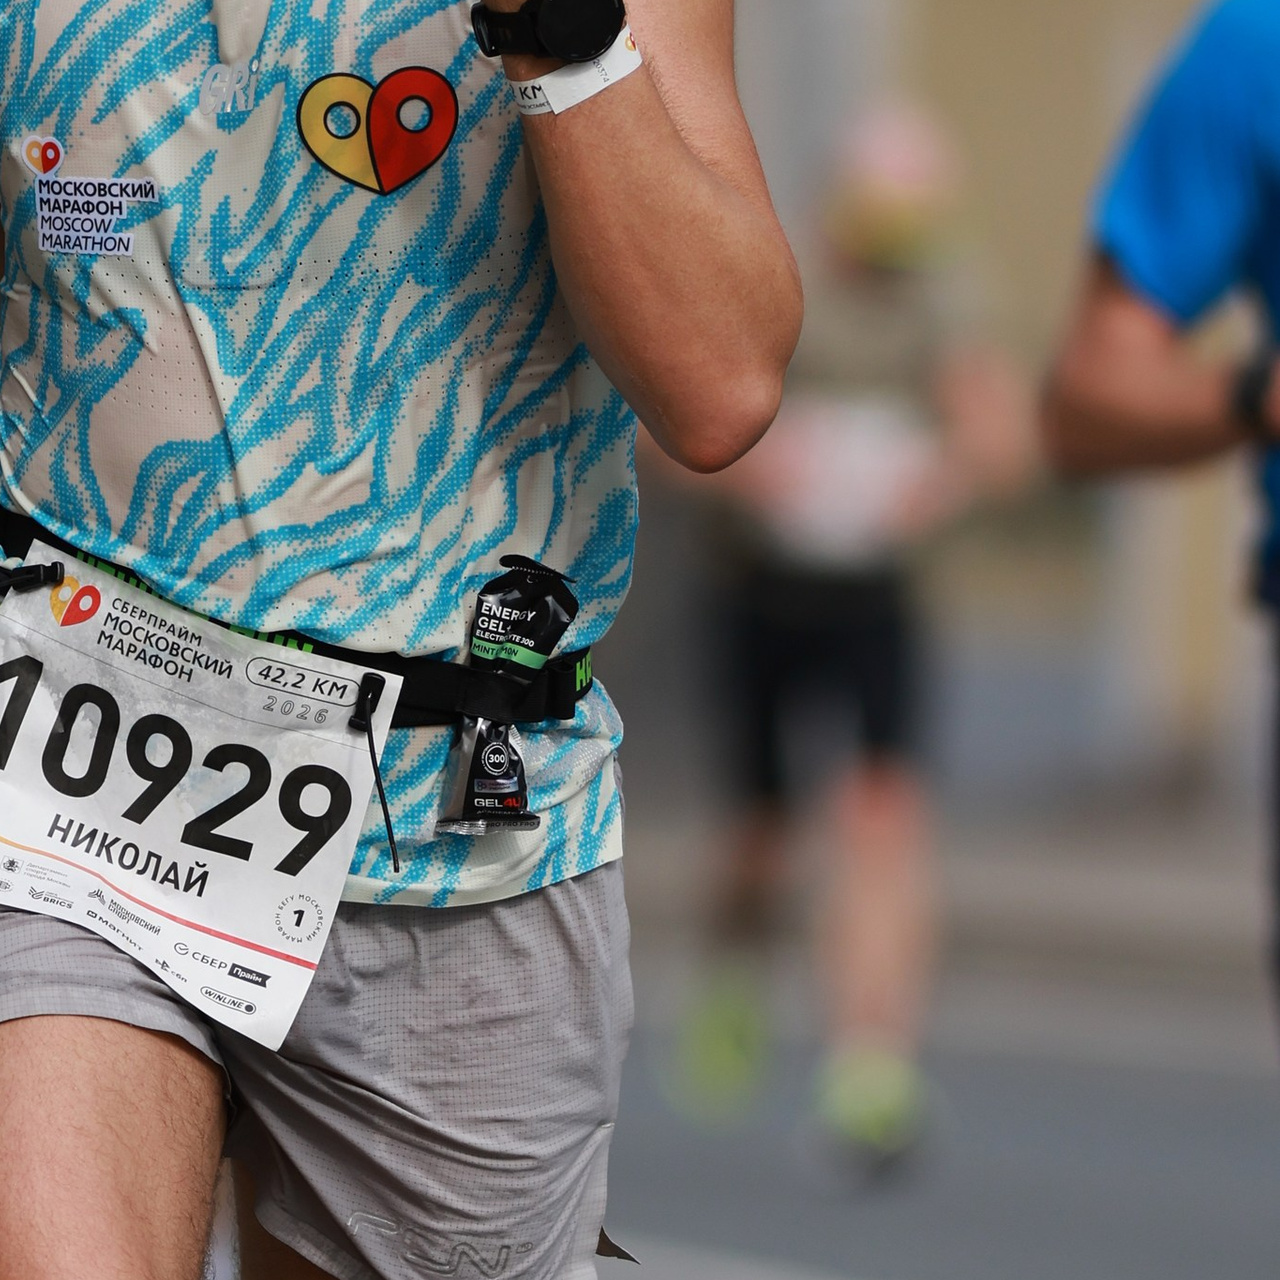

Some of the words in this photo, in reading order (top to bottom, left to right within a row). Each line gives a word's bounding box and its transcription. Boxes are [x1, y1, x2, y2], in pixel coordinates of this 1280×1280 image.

[38, 179, 155, 199] МОСКОВСКИЙ
[39, 197, 123, 216] МАРАФОН
[40, 215, 113, 233] MOSCOW
[41, 233, 130, 252] MARATHON
[111, 597, 203, 647] СБЕРПРАЙМ
[481, 602, 536, 622] ENERGY
[102, 612, 233, 679] МОСКОВСКИЙ
[472, 643, 495, 656] MINT
[97, 630, 193, 683] МАРАФОН
[258, 665, 306, 690] 42,2
[311, 678, 348, 700] КМ
[263, 695, 329, 724] 2026
[488, 754, 505, 763] 300
[47, 813, 210, 898] НИКОЛАЙ
[43, 896, 73, 909] BRICS
[108, 903, 131, 924] СПОРТ
[109, 899, 161, 936] МОСКОВСКИЙ
[293, 909, 306, 928] 1
[191, 951, 228, 970] СБЕР
[233, 967, 263, 983] Прайм
[204, 989, 245, 1009] WINLINE
